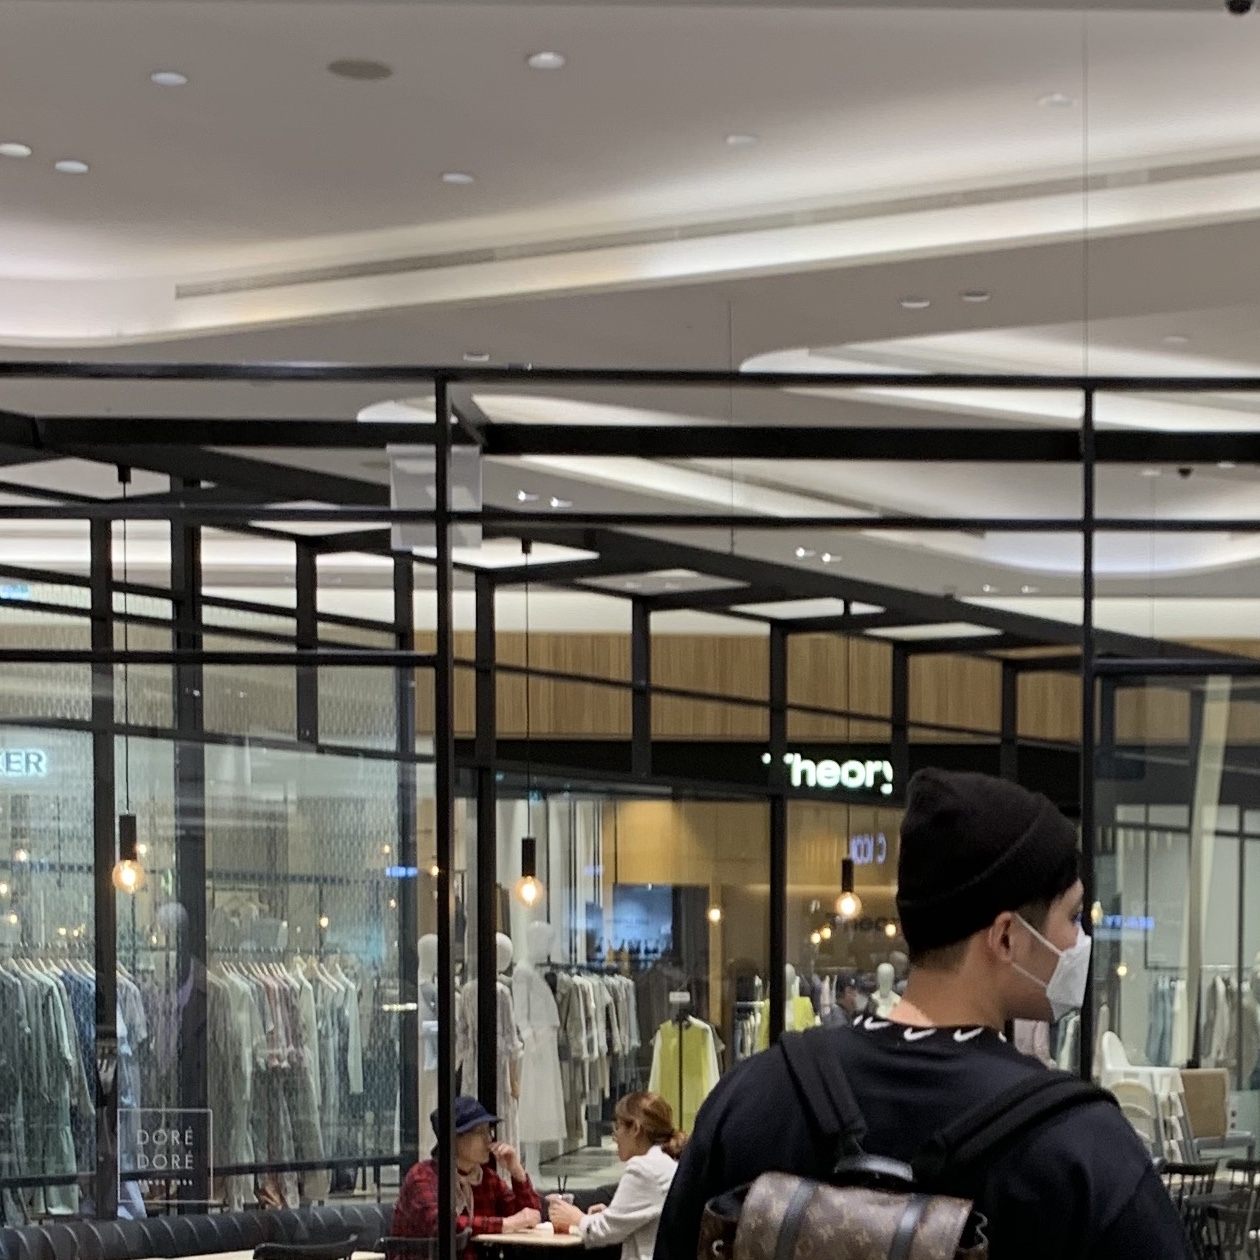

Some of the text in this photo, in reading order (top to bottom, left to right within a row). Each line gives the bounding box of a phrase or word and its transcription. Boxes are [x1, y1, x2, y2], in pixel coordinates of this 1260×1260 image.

[0, 750, 44, 773] ER
[136, 1125, 194, 1146] DORÉ
[136, 1150, 195, 1170] DORÉ
